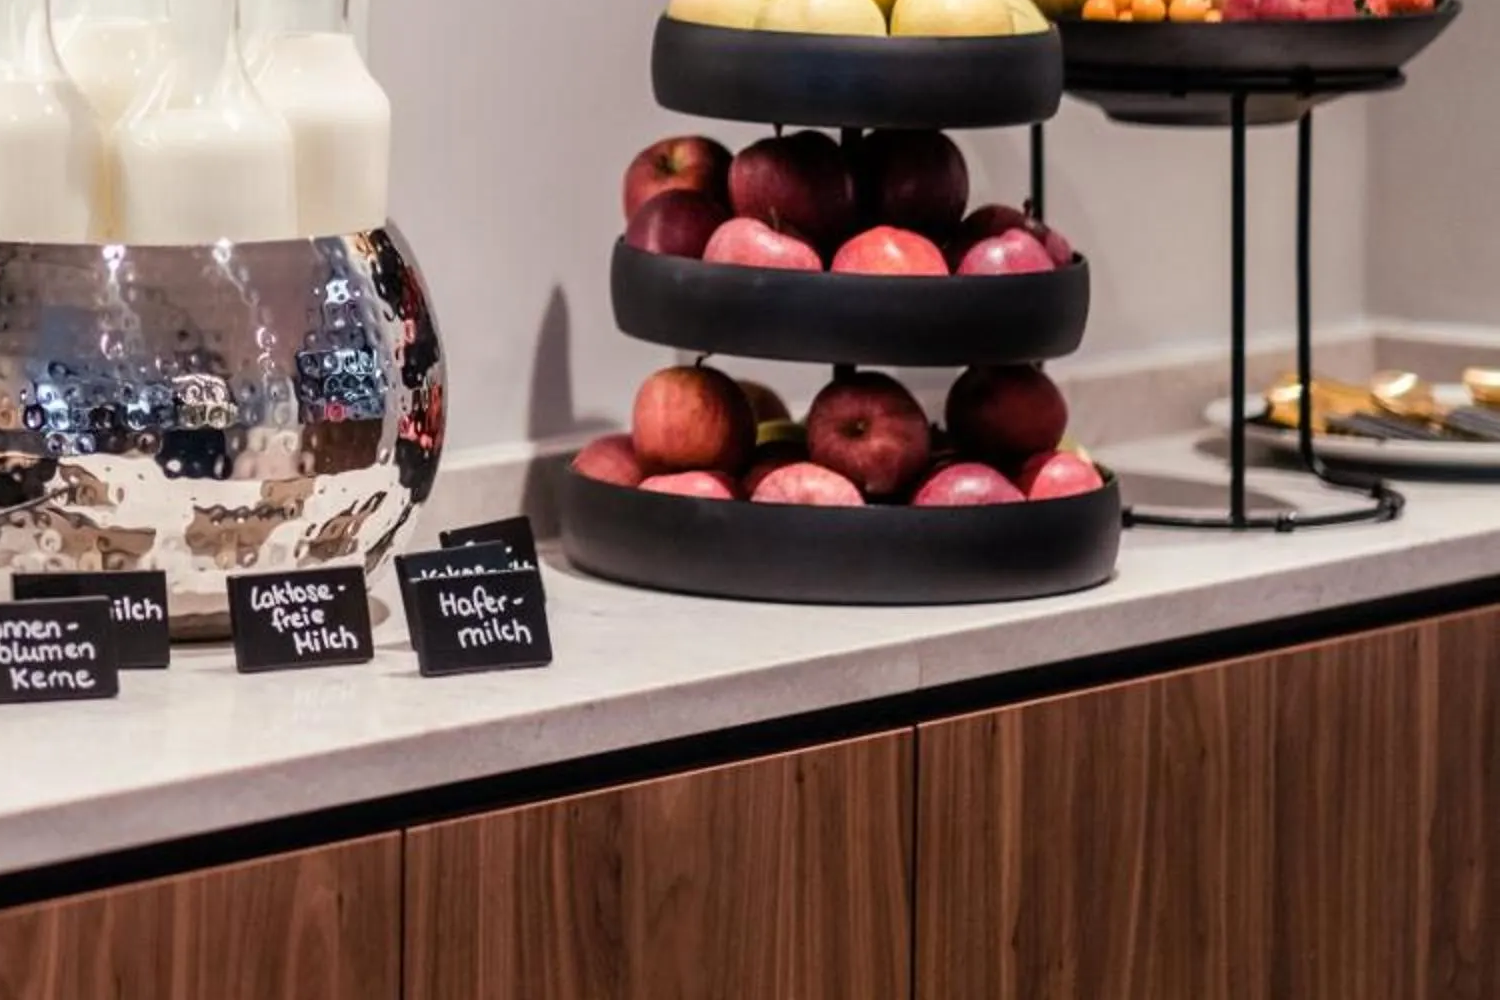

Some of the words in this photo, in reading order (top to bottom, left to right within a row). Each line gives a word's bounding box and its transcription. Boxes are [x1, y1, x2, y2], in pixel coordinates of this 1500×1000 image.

[110, 596, 163, 621] ilch
[272, 607, 325, 633] freie
[293, 625, 359, 656] Milch
[457, 617, 532, 649] milch
[9, 667, 96, 690] Kerne
